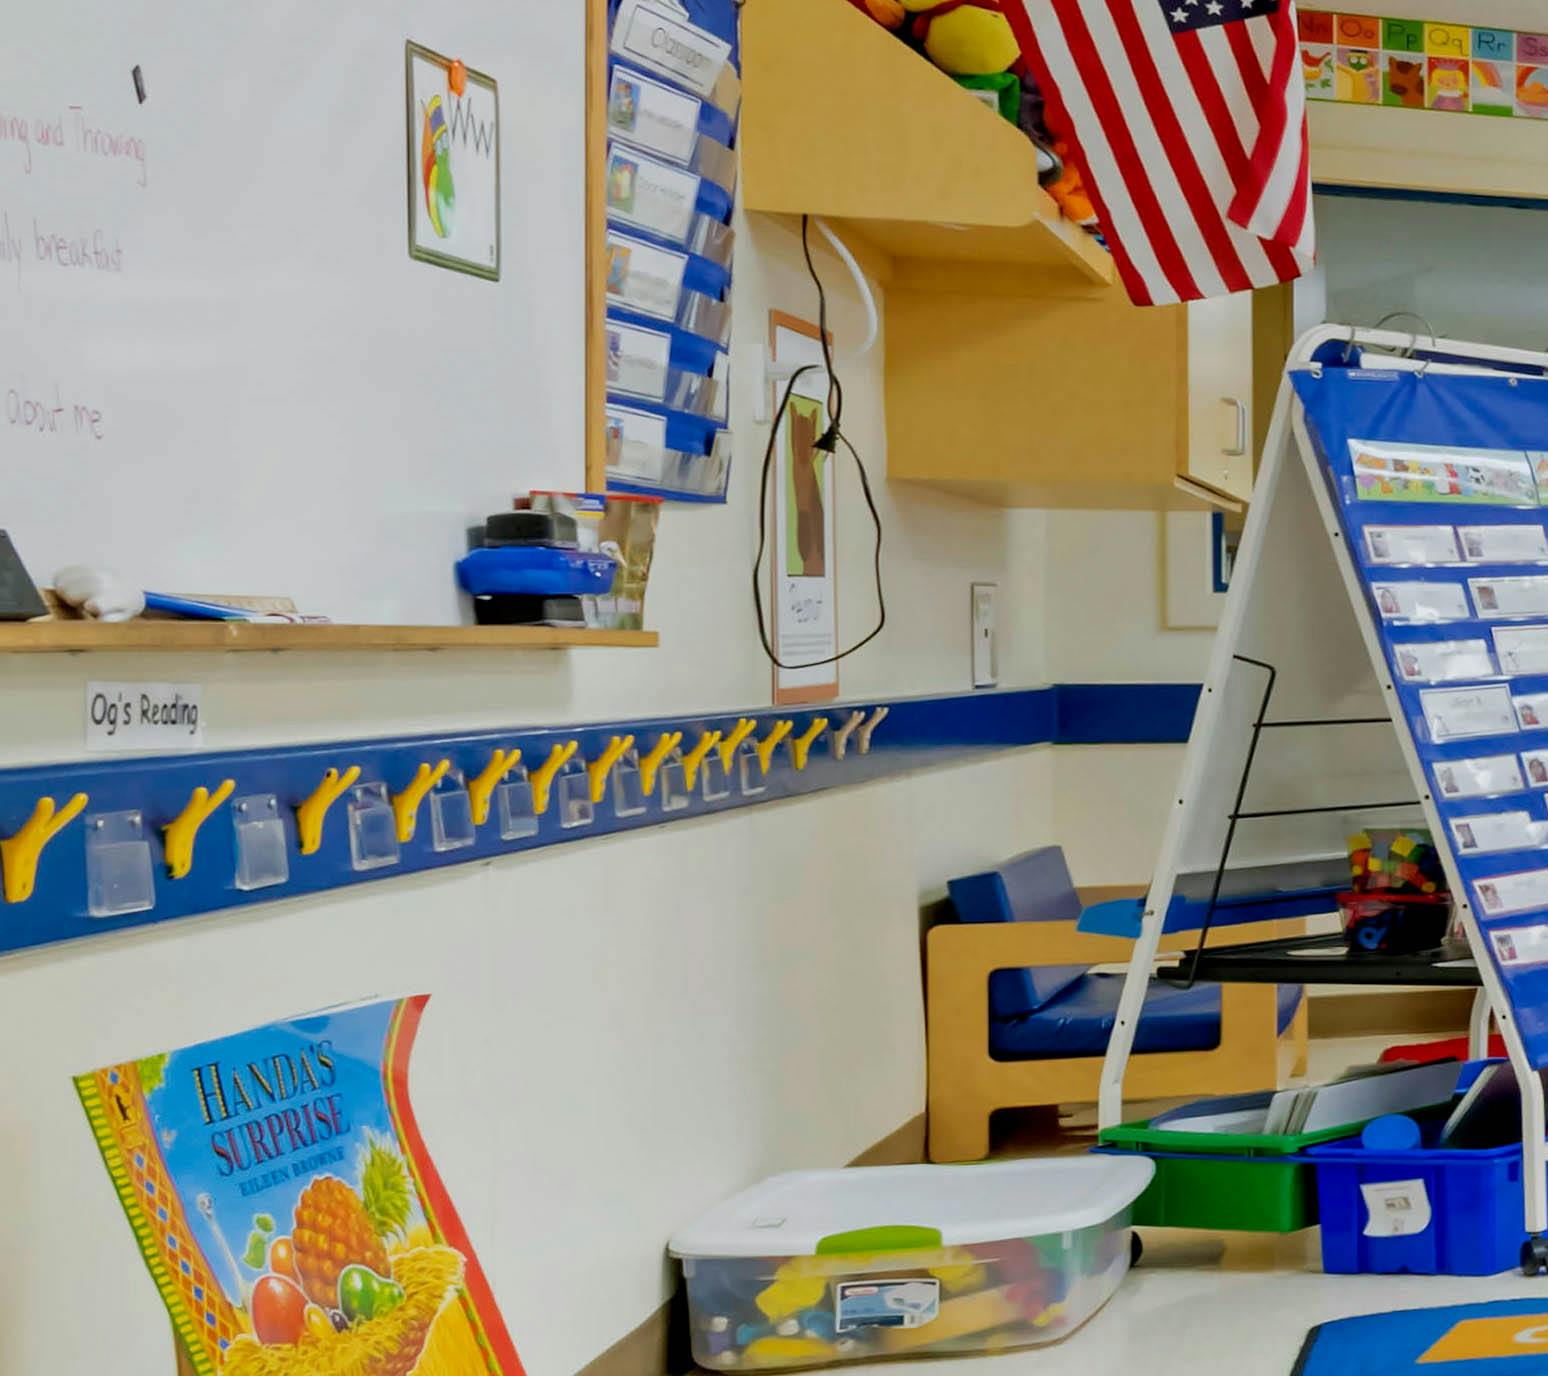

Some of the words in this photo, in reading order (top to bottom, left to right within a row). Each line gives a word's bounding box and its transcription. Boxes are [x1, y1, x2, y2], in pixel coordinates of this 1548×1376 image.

[1339, 16, 1375, 39] Oo
[1427, 28, 1469, 58] Qq
[1476, 31, 1507, 51] Rr
[91, 692, 132, 736] Og's
[140, 692, 199, 736] Reading
[192, 1039, 337, 1126] HANDA'S
[211, 1092, 352, 1178] SURPRISE
